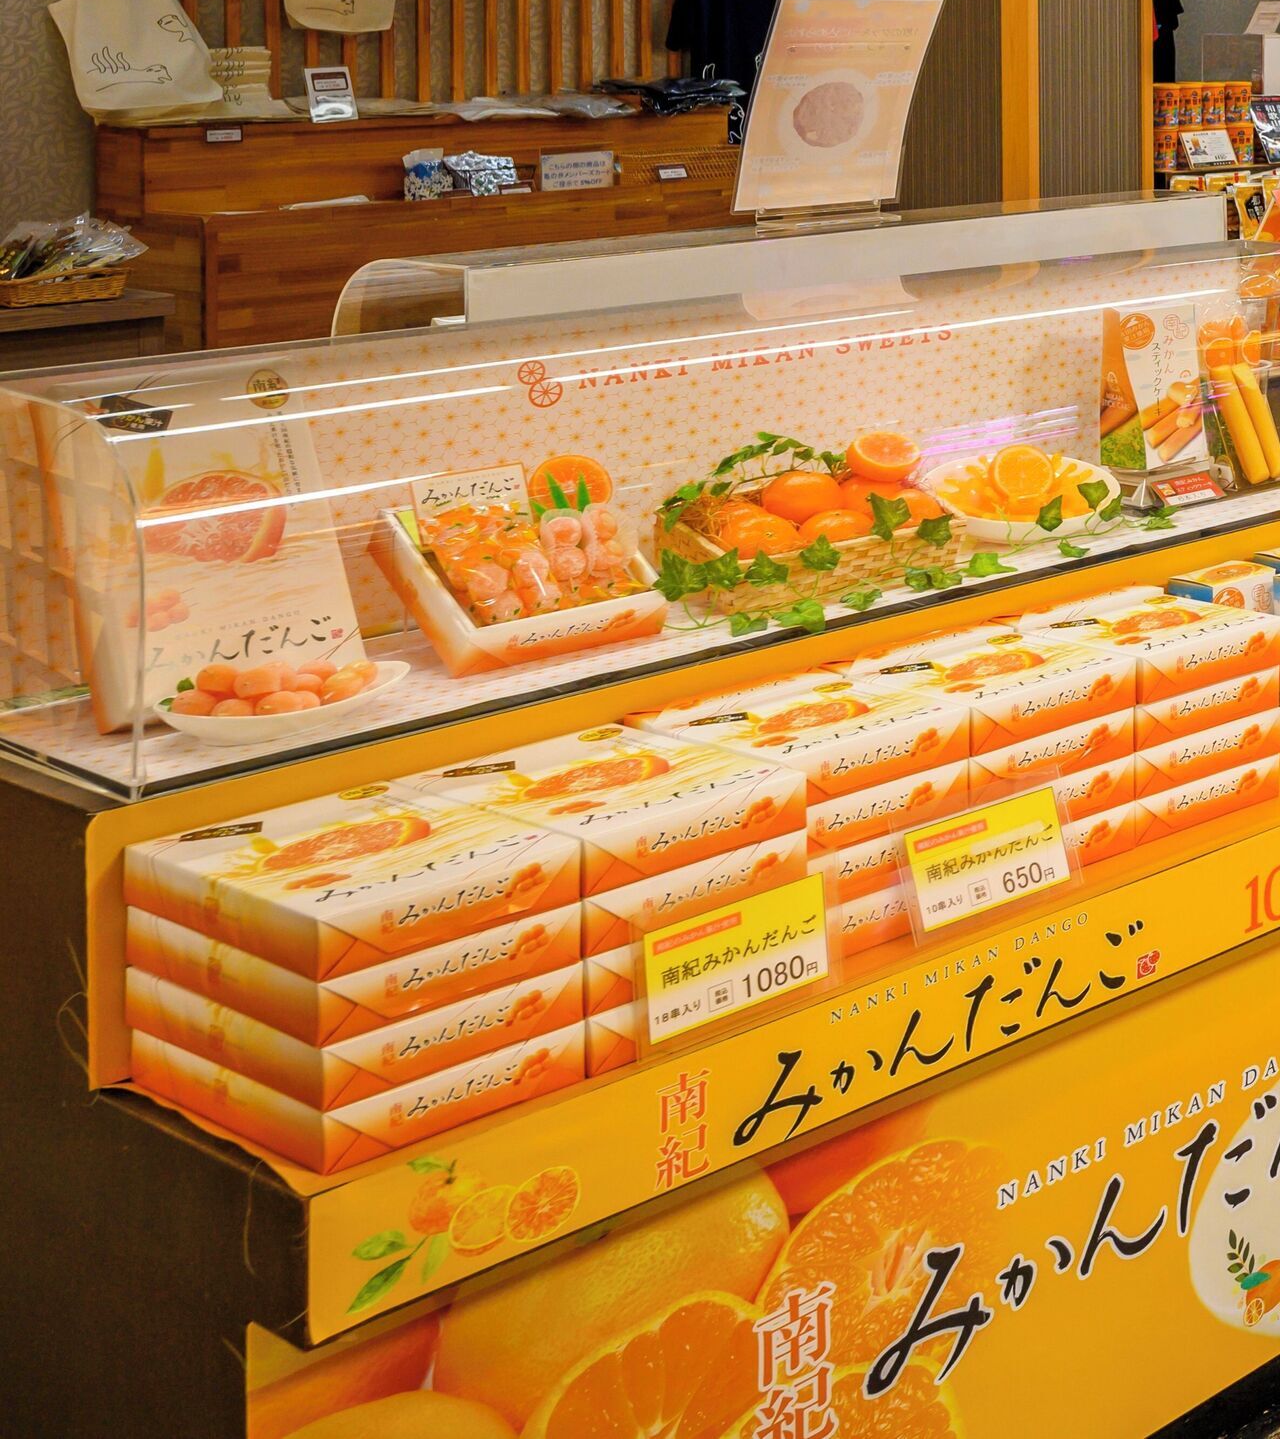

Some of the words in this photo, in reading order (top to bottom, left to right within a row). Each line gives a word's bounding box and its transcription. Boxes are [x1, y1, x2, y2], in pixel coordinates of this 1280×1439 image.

[578, 356, 689, 389] NANKI
[711, 340, 815, 372] MIKAN
[836, 323, 953, 355] SWEETS
[1151, 342, 1162, 417] スティックケーキ
[1163, 335, 1174, 374] みかん
[421, 476, 515, 506] みかんだんご
[520, 618, 609, 645] みかんだんご
[1185, 640, 1248, 670] みかんだんご
[1021, 684, 1093, 718] みかんだんご
[1179, 686, 1243, 717] みかんだんご
[833, 739, 915, 775] みかんだんご
[1018, 735, 1089, 768] みかんだんご
[1179, 733, 1243, 764] みかんだんご
[828, 793, 909, 830] みかんだんご
[1177, 779, 1240, 810] みかんだんご
[651, 810, 747, 851] みかんだんご
[925, 824, 1053, 883] 南紀みかんだんご
[398, 876, 510, 926] みかんだんご
[658, 866, 752, 912] みかんだんご
[926, 894, 963, 915] 10串入り
[1002, 862, 1055, 894] 650円
[403, 938, 514, 989] みかんだんご
[661, 914, 817, 989] 南紀みかんだんご
[830, 981, 911, 1025] NANKI
[923, 949, 1001, 988] MIKAN
[1013, 911, 1091, 953] DANGO
[654, 1000, 701, 1025] 18串入り
[742, 955, 818, 998] 1080円
[400, 1005, 512, 1057] みかんだんご
[733, 919, 1145, 1147] みかんだんご
[407, 1063, 518, 1117] みかんだんご
[655, 1068, 708, 1190] 南紀
[997, 1138, 1108, 1208] NANKI
[1124, 1081, 1225, 1148] MIKAN
[754, 1282, 836, 1439] 南紀
